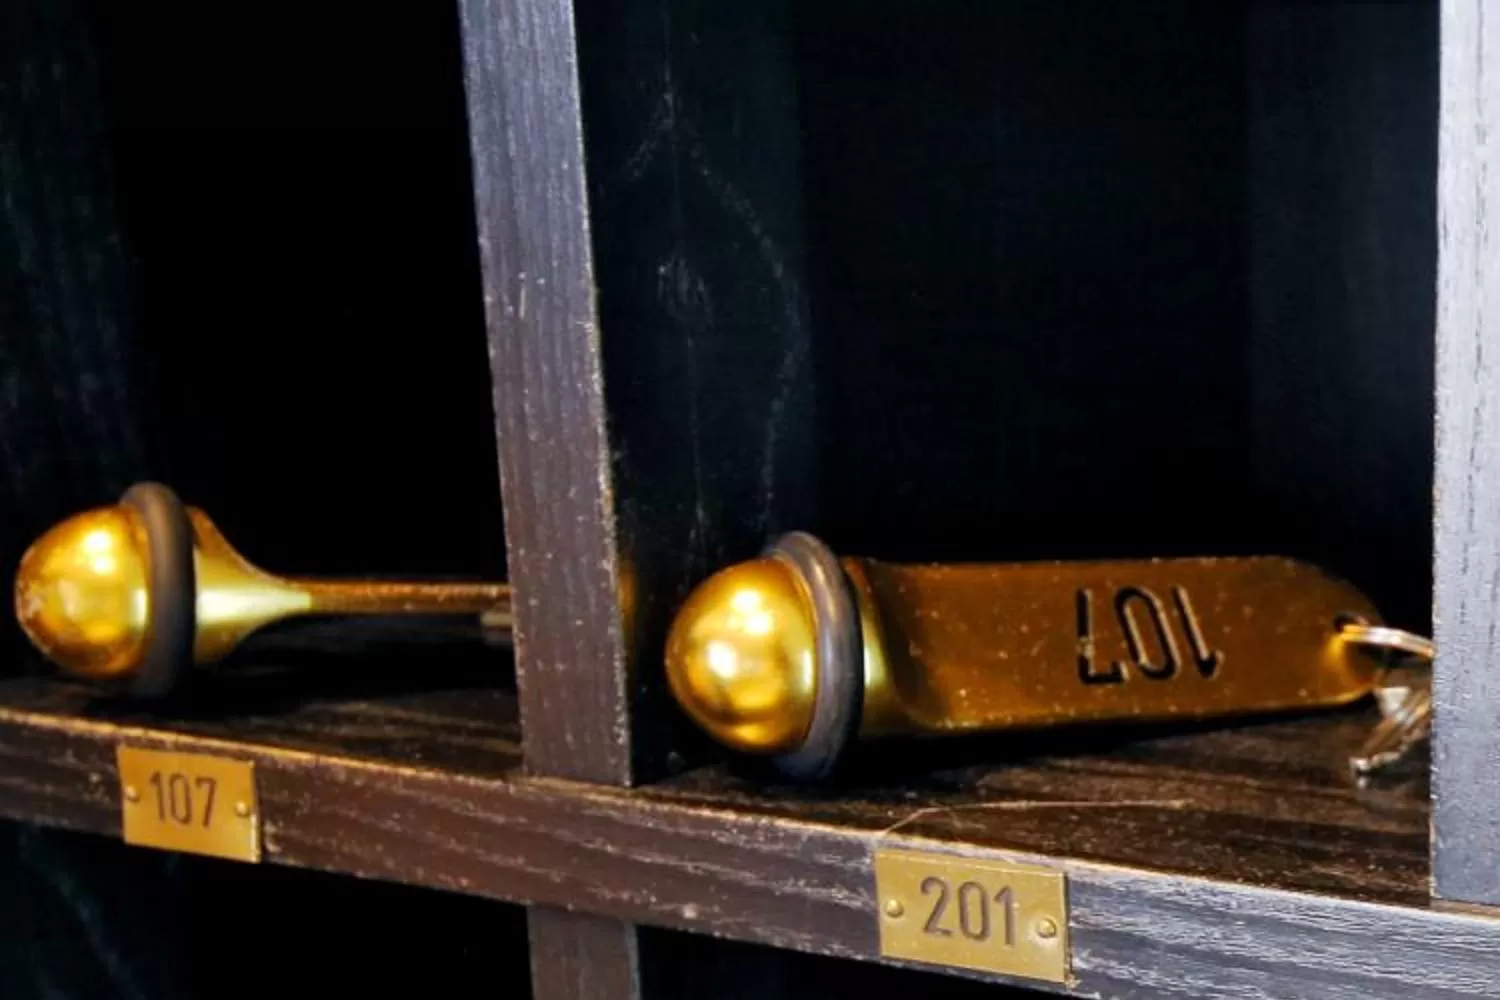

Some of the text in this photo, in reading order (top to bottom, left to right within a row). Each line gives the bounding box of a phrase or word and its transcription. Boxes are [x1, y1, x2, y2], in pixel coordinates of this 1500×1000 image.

[1077, 585, 1224, 687] 107
[150, 770, 217, 829] 107
[920, 875, 1017, 946] 201
